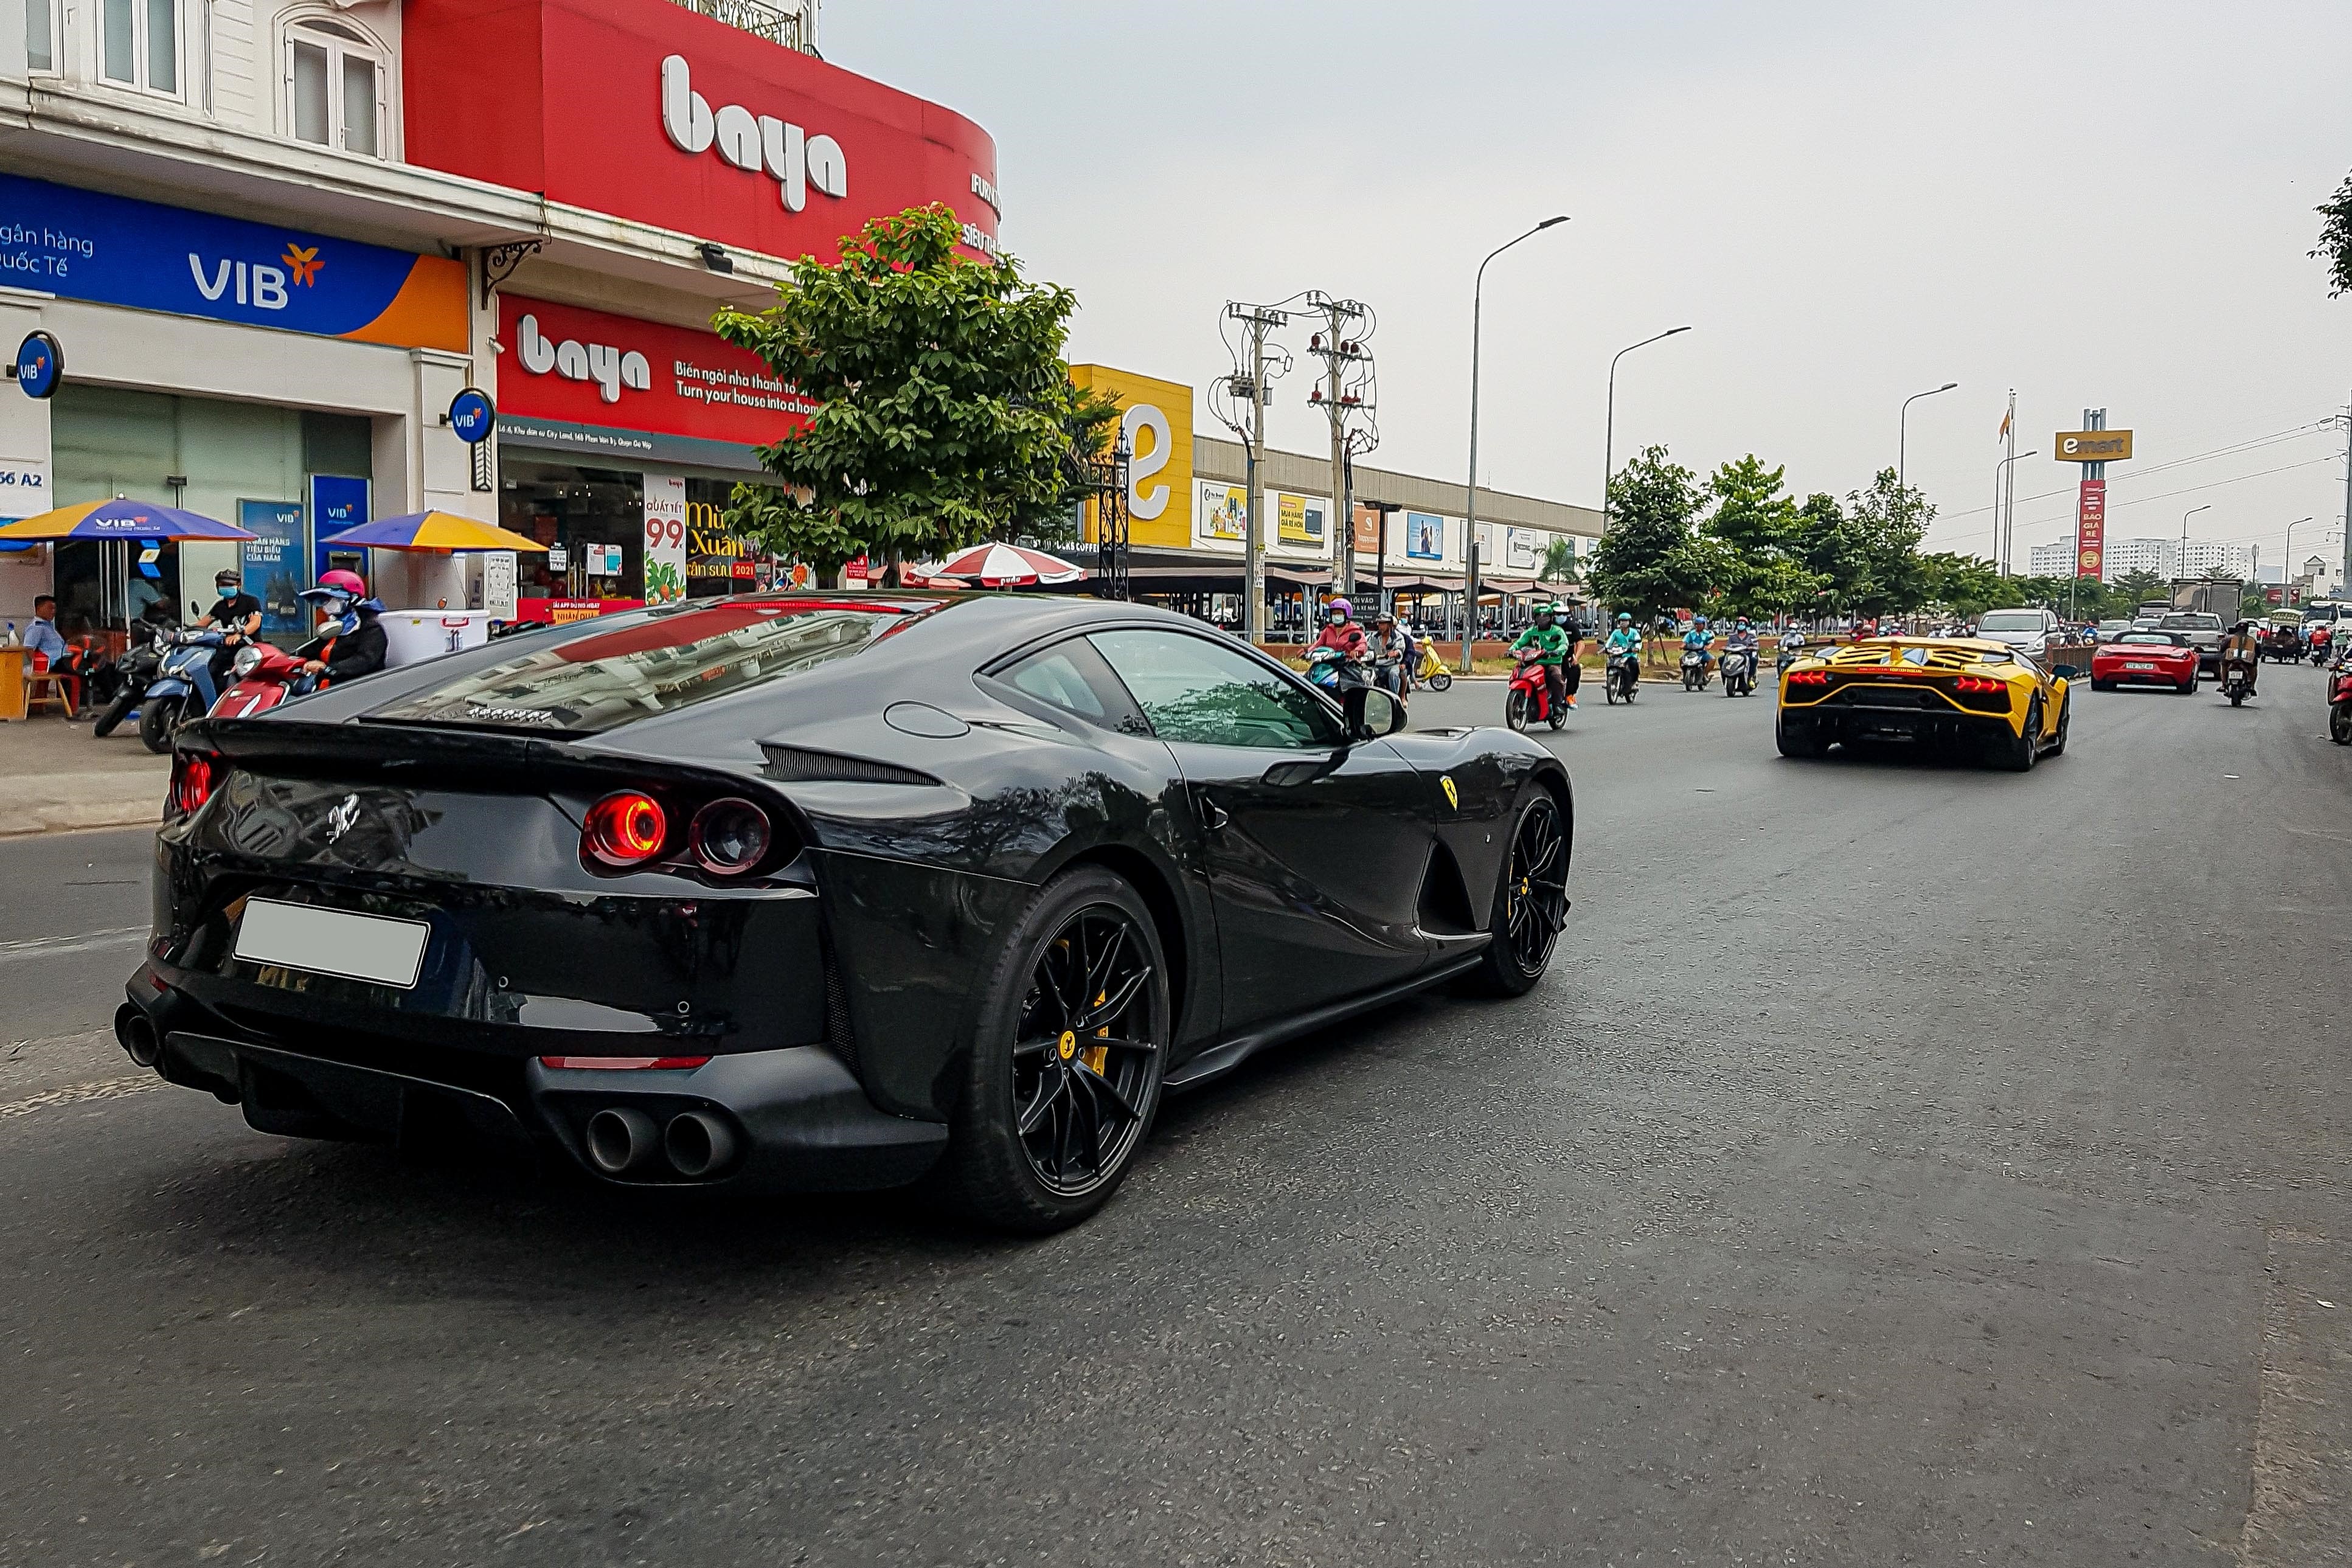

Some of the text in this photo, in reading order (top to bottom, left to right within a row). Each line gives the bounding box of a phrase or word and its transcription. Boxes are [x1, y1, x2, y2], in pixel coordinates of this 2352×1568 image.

[662, 54, 847, 212] baya
[0, 223, 93, 258] gân hàng
[0, 251, 68, 277] uốc Tế
[189, 252, 288, 310] VIB
[20, 364, 38, 379] VIB
[518, 314, 651, 403] baya
[675, 361, 699, 378] Biến
[676, 381, 819, 415] Turn your house into a hom
[456, 415, 474, 427] VIB
[2063, 437, 2124, 454] emart
[1123, 404, 1172, 521] e
[21, 472, 42, 487] A2
[95, 518, 136, 528] VIB
[276, 512, 294, 524] VIB
[328, 507, 347, 518] VIB
[685, 501, 731, 531] Mù
[647, 518, 684, 550] 99
[690, 527, 744, 558] Xuân
[735, 565, 754, 575] 2021
